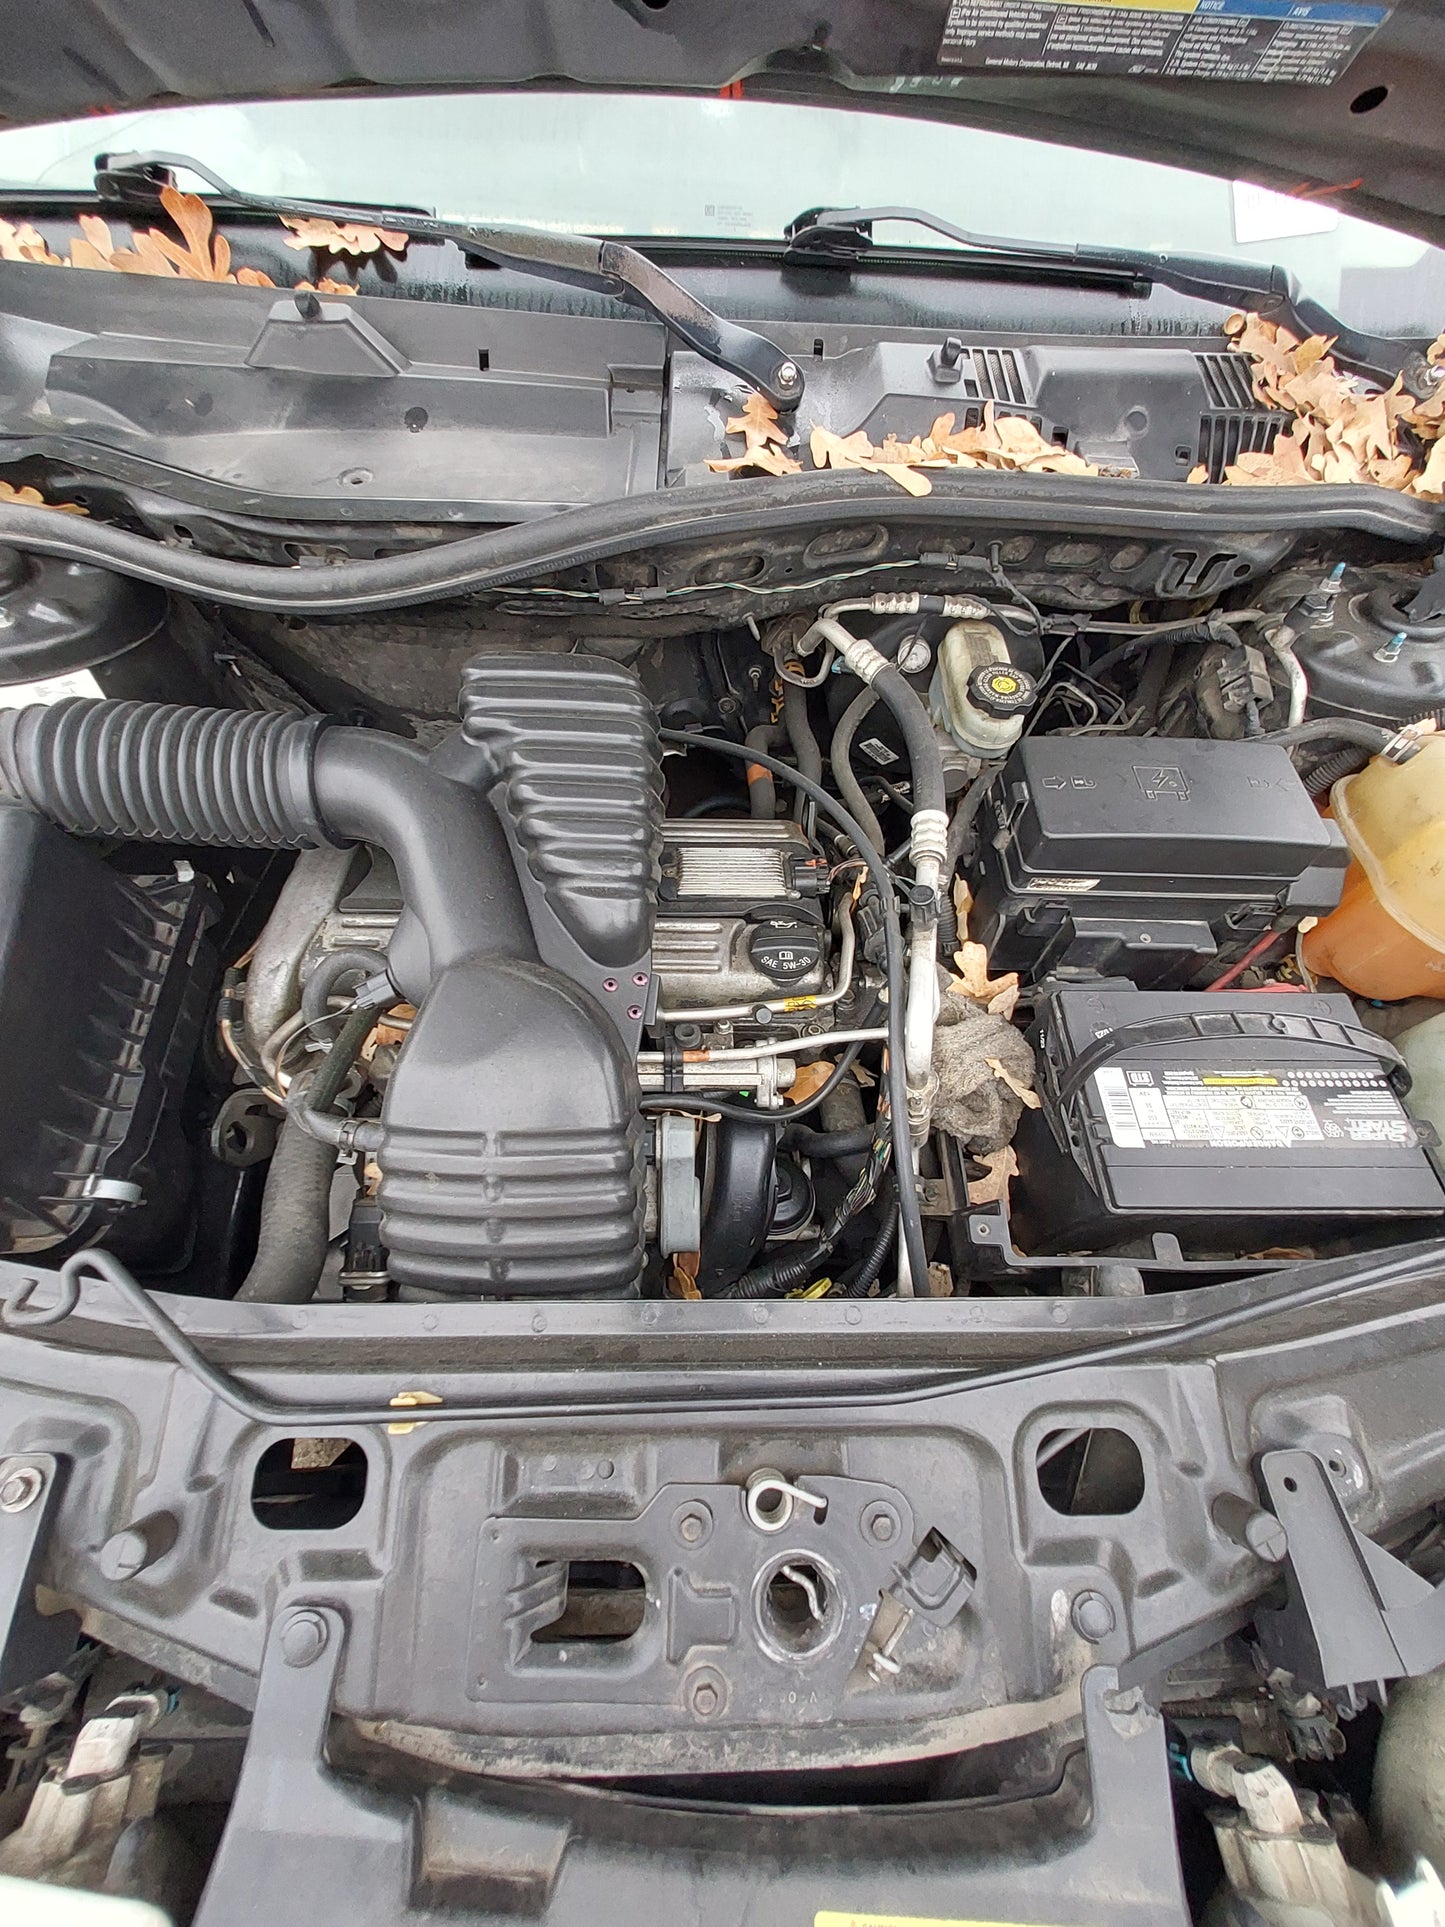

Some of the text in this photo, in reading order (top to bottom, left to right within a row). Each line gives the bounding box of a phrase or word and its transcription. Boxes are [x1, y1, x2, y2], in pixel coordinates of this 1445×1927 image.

[1200, 1, 1225, 10] NOTICE
[1293, 7, 1312, 16] AVIS
[1003, 58, 1019, 67] Motors
[761, 956, 811, 970] SAE 5W-30
[1345, 1120, 1407, 1133] START
[1350, 1130, 1407, 1142] SUPER
